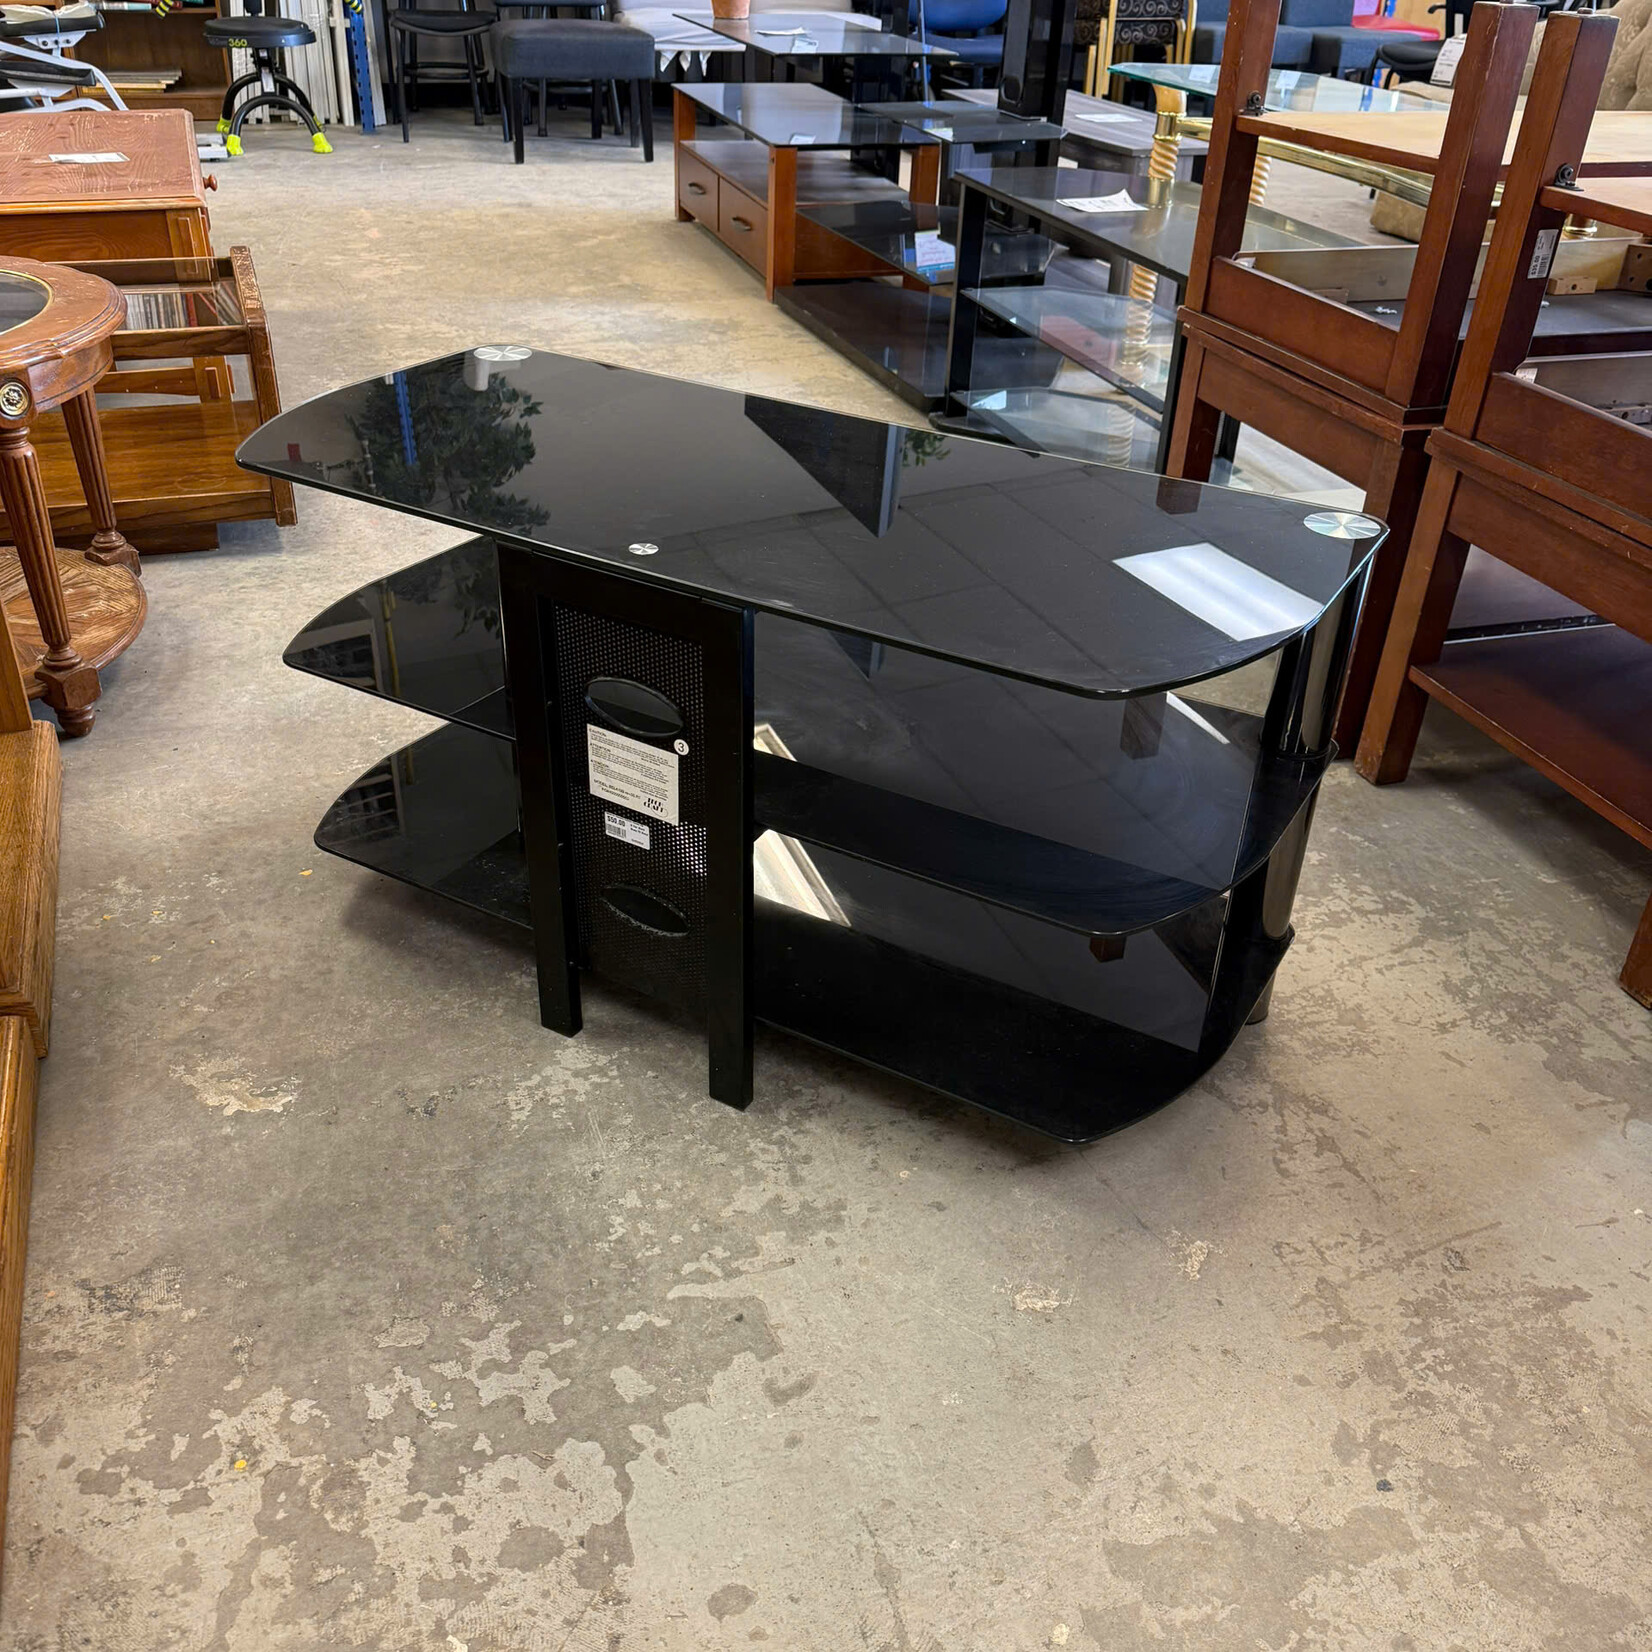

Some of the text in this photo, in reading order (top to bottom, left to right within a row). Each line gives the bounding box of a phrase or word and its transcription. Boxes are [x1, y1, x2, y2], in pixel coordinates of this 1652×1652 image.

[228, 38, 248, 47] 360
[678, 742, 685, 752] 3
[607, 815, 625, 827] $50.00
